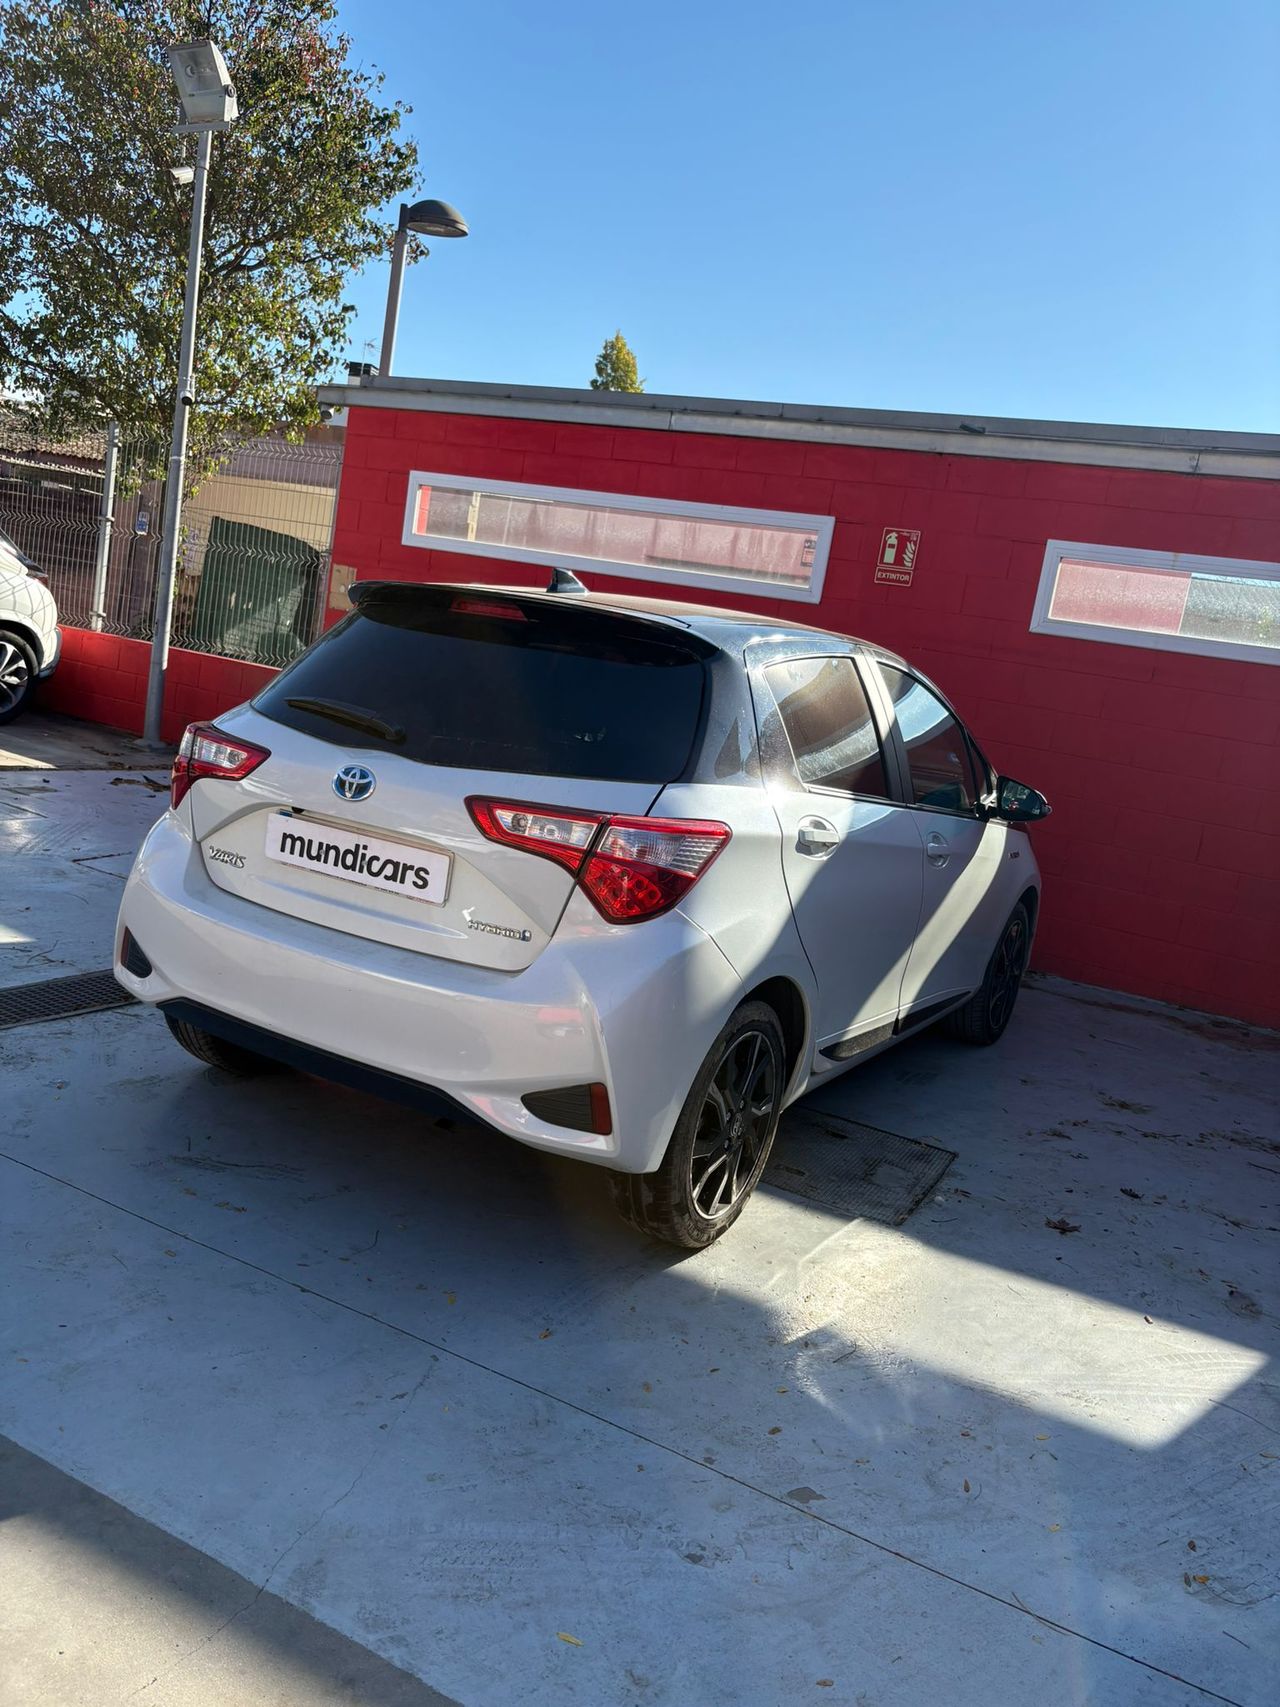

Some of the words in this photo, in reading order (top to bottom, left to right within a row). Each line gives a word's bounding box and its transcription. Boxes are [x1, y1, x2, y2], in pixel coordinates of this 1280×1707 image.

[877, 572, 910, 582] EXTINTOR
[209, 845, 246, 869] YARIS
[280, 832, 430, 890] mundicars
[467, 919, 521, 940] HYBRID
